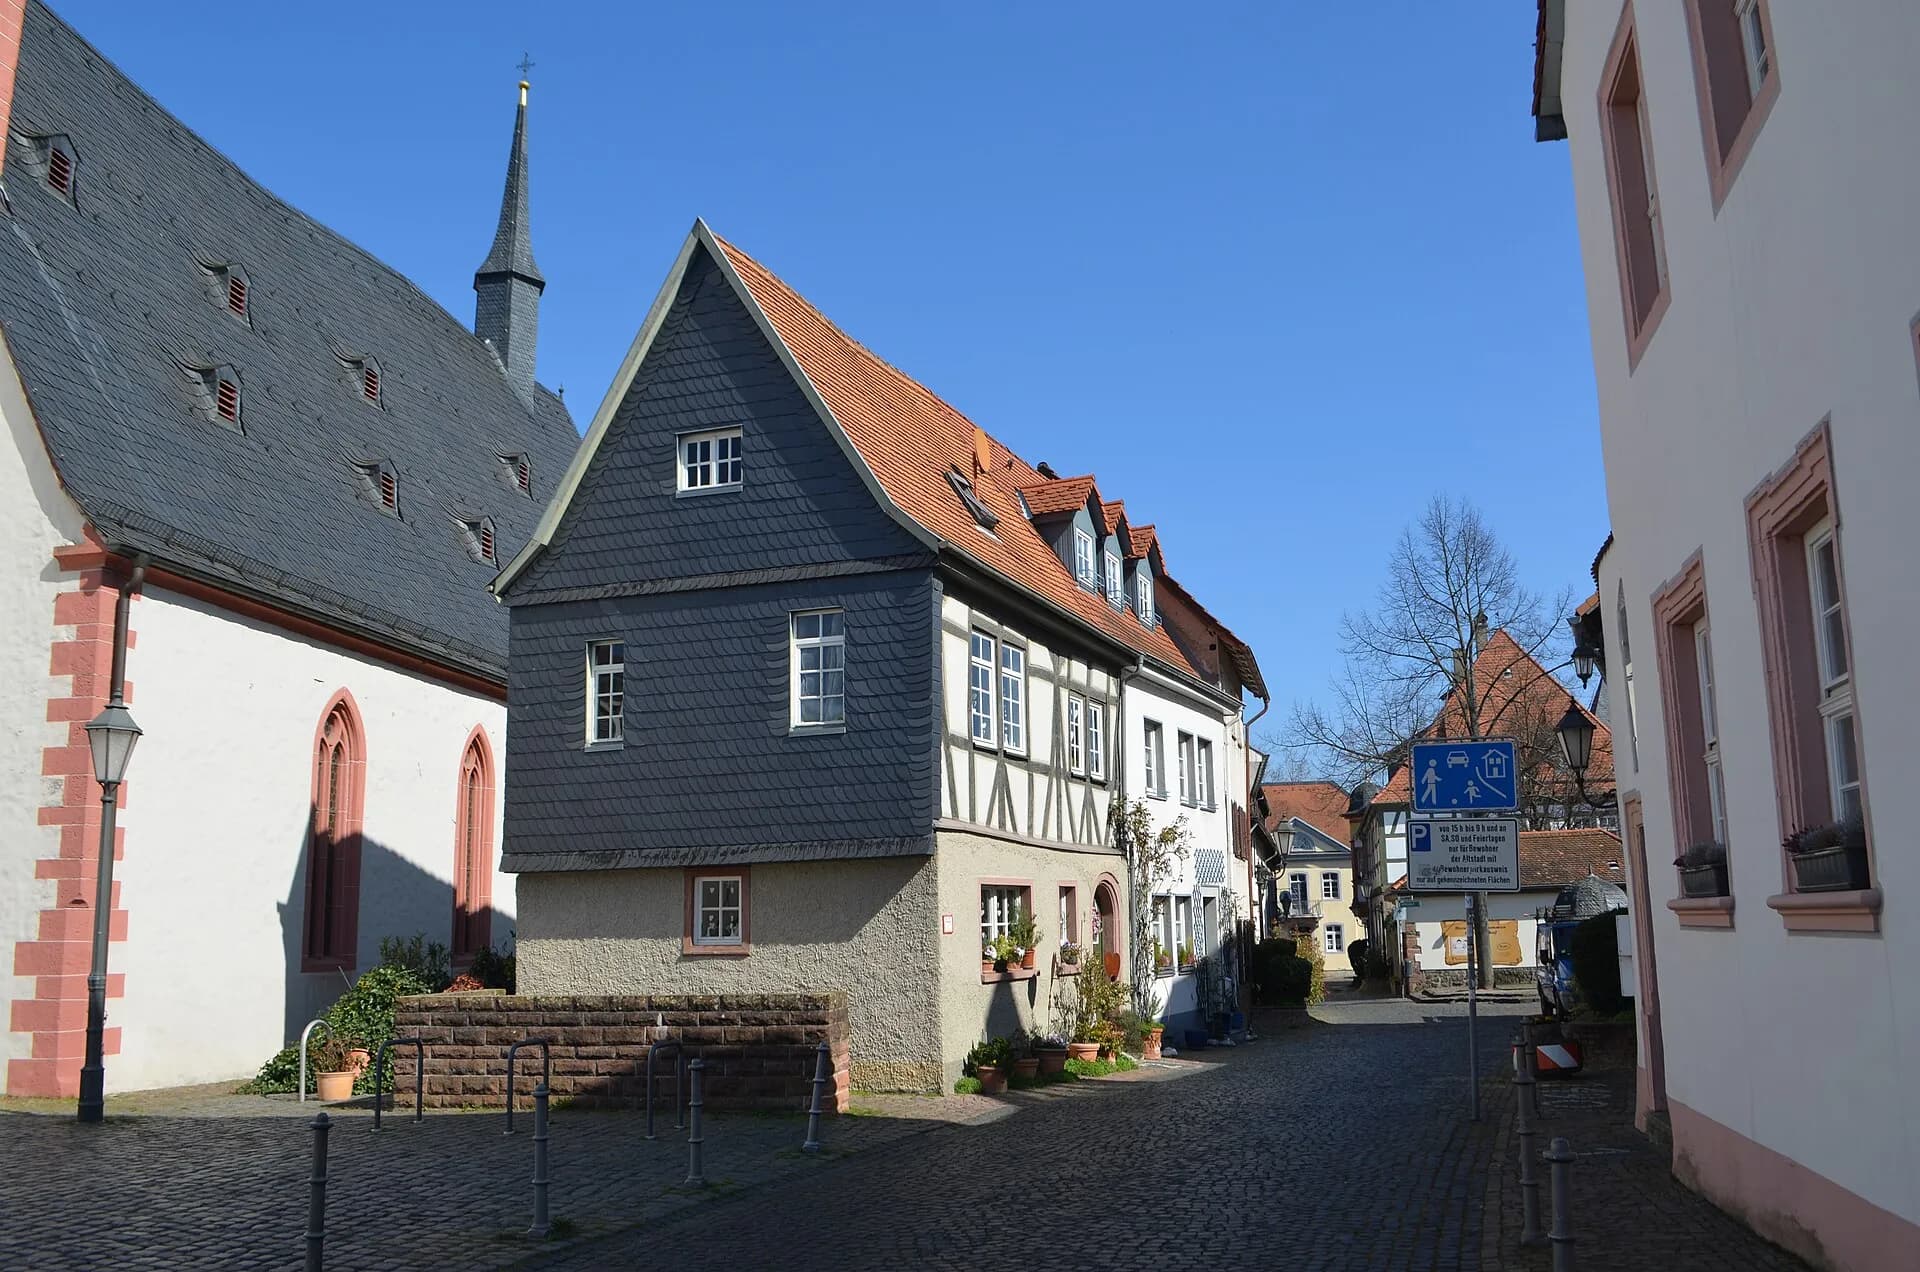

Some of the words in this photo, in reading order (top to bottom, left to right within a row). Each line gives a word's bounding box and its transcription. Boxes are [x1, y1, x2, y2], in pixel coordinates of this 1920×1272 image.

[1411, 825, 1427, 848] P
[1473, 835, 1505, 843] Feiertagen
[1451, 855, 1461, 863] der
[1462, 855, 1485, 863] Altstadt
[1437, 876, 1486, 884] gekennzeichneten
